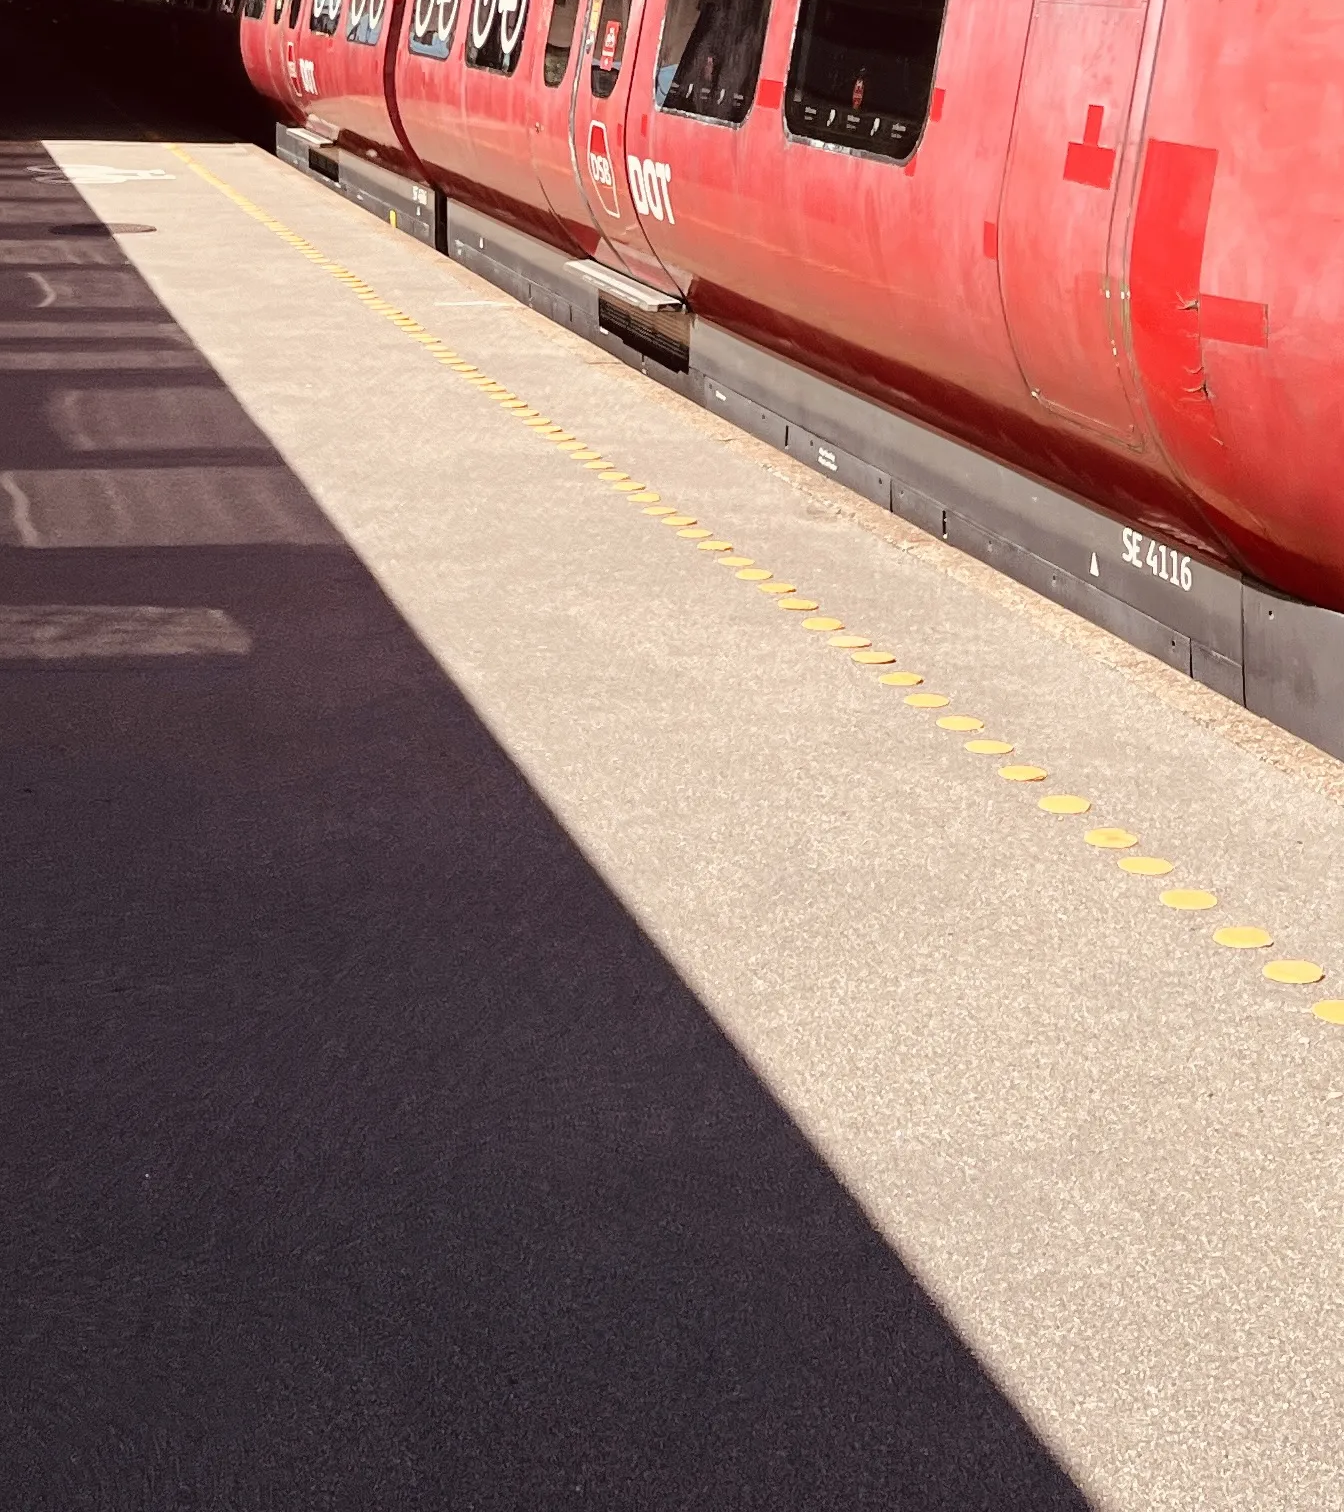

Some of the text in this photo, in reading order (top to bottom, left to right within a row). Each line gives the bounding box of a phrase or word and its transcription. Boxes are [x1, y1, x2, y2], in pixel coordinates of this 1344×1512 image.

[589, 153, 612, 186] DSB
[627, 154, 675, 225] DOT
[1121, 527, 1193, 592] SE 4116
